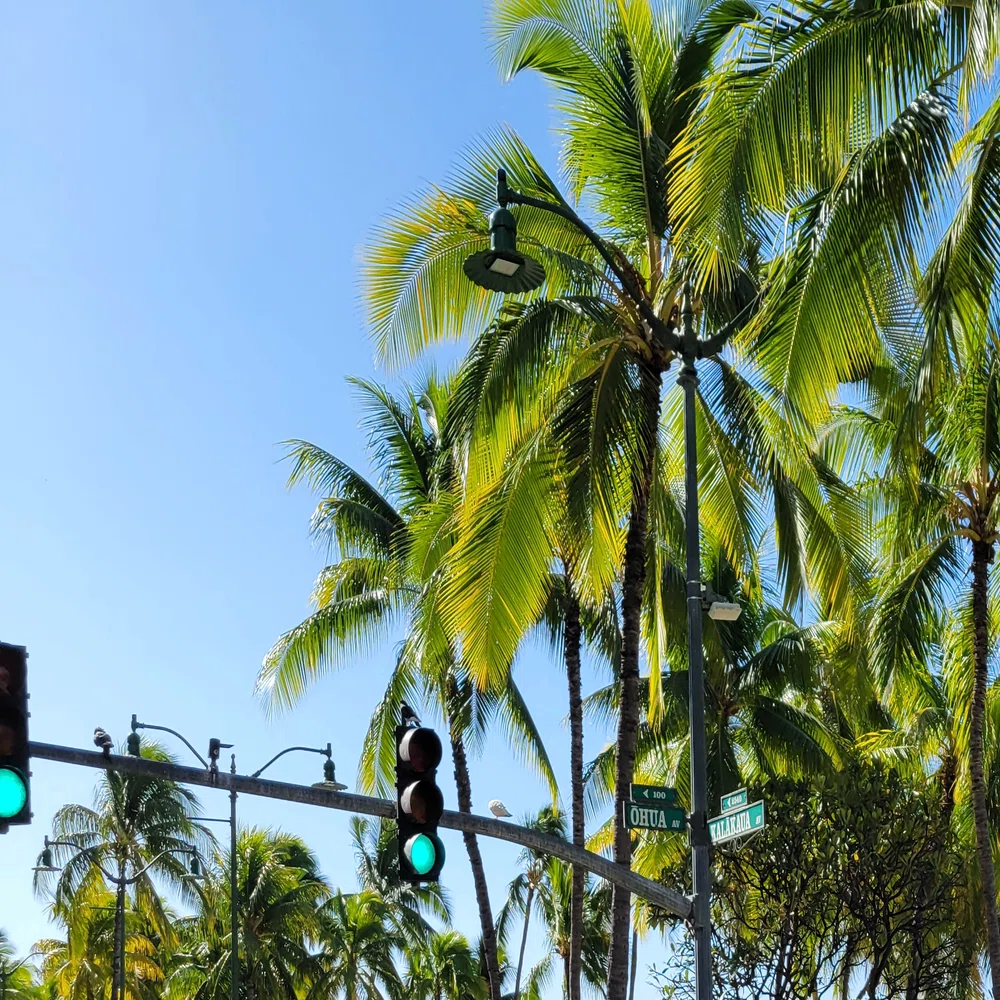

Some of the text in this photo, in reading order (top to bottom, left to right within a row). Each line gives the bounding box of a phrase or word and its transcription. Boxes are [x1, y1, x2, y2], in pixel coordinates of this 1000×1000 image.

[653, 791, 666, 799] 100
[630, 805, 680, 829] ŌHUA AV
